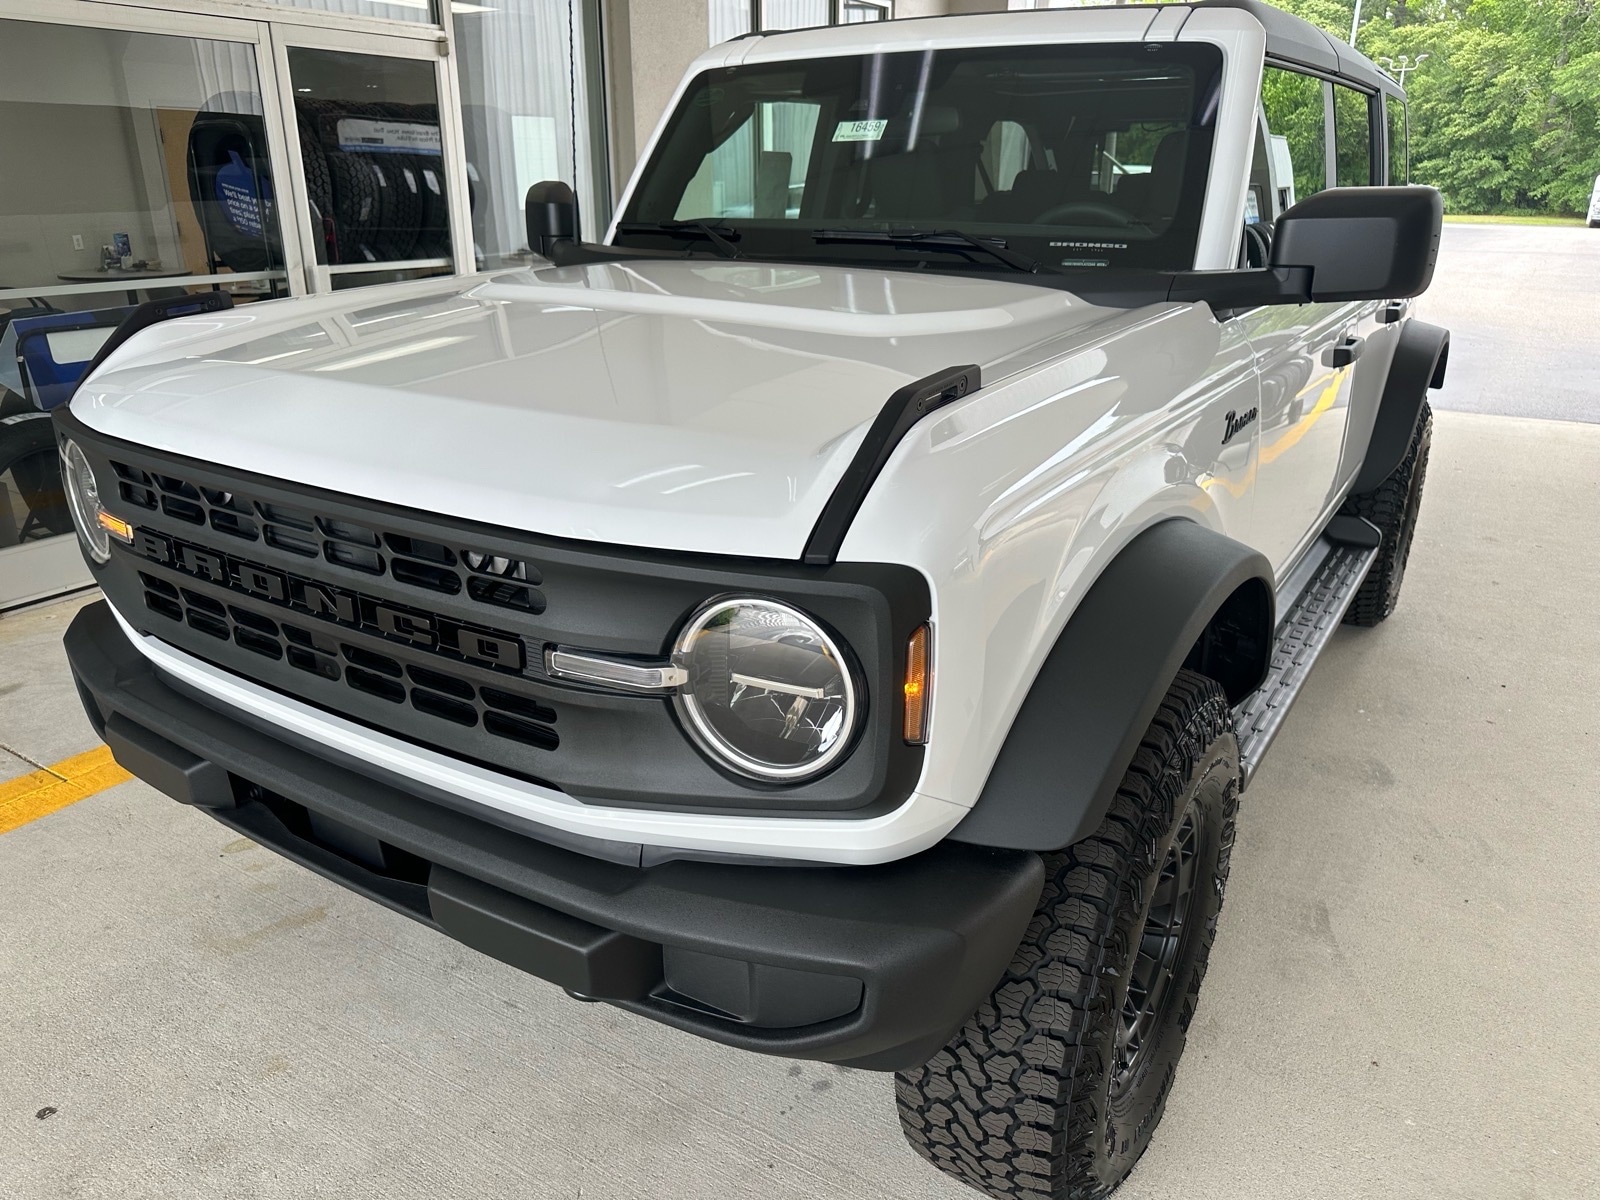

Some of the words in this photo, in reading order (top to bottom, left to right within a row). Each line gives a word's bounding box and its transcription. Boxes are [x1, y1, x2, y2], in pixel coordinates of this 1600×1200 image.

[851, 121, 882, 133] 16459
[1049, 241, 1127, 249] BRONCO
[1221, 407, 1258, 445] Bronco
[135, 534, 522, 669] BRONCO
[1270, 591, 1329, 670] BRONCO
